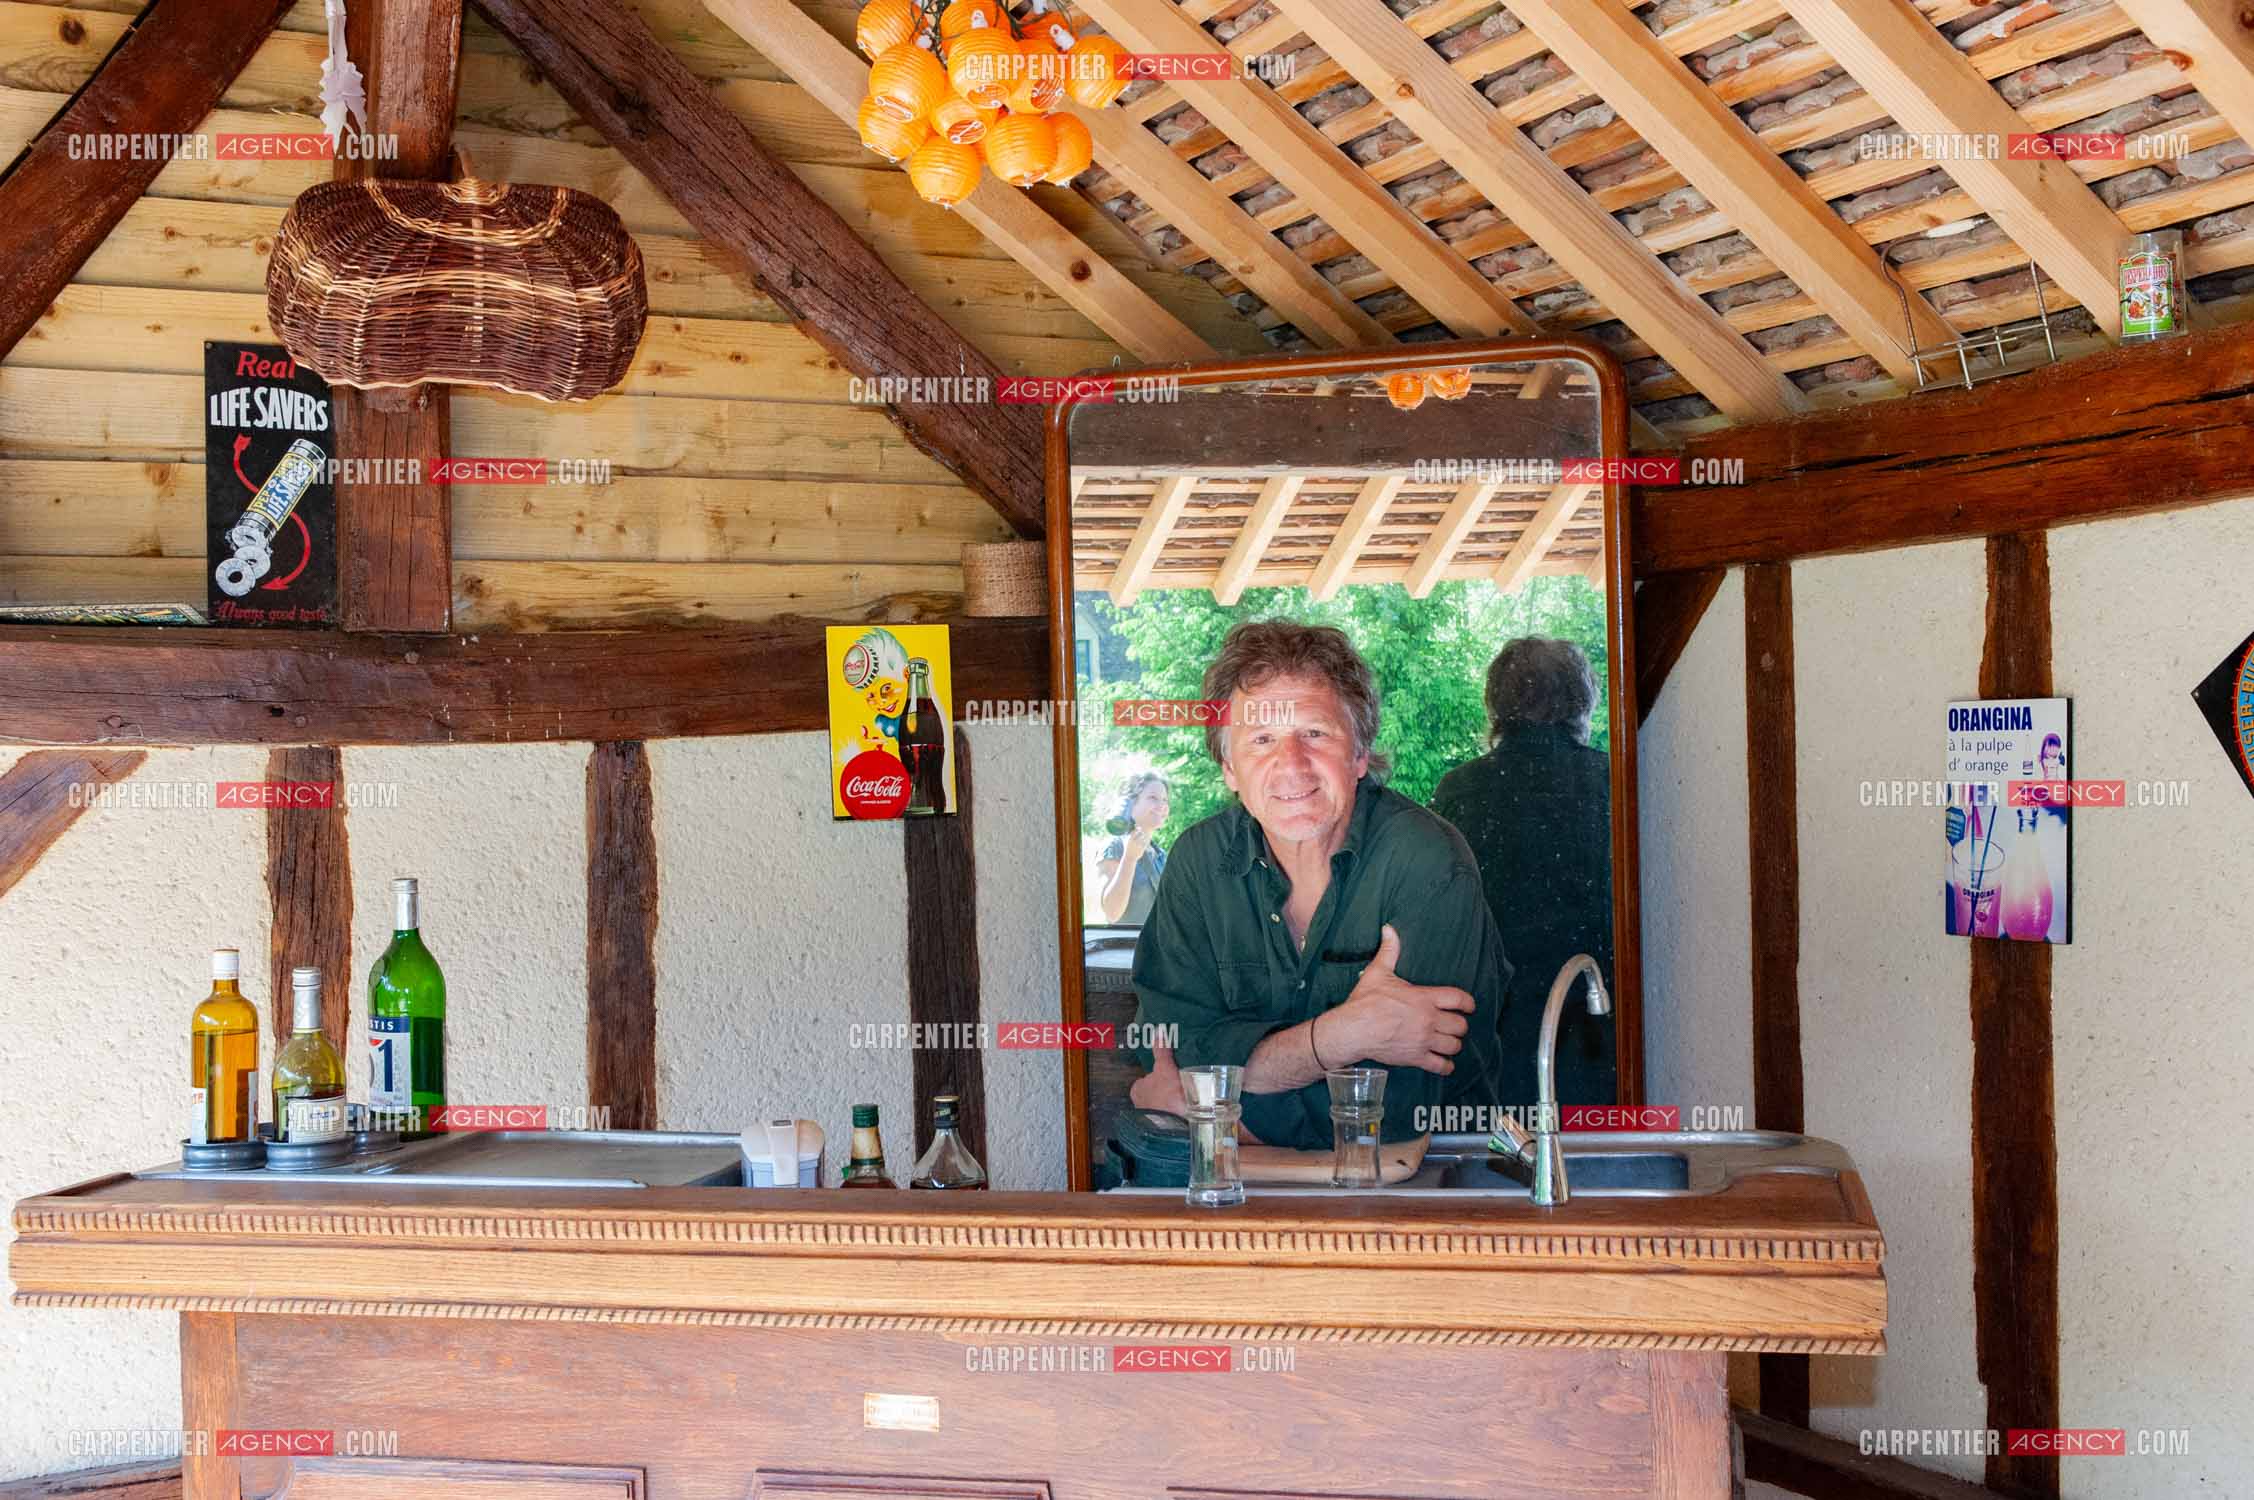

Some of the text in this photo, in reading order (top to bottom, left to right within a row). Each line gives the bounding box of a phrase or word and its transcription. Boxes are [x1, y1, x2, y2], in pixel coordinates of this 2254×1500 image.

[236, 350, 298, 379] Real
[210, 386, 329, 431] LIFE SAVERS
[1948, 706, 2033, 733] ORANGINA
[1948, 738, 2013, 757] à la pulpe
[1964, 760, 2009, 775] orange
